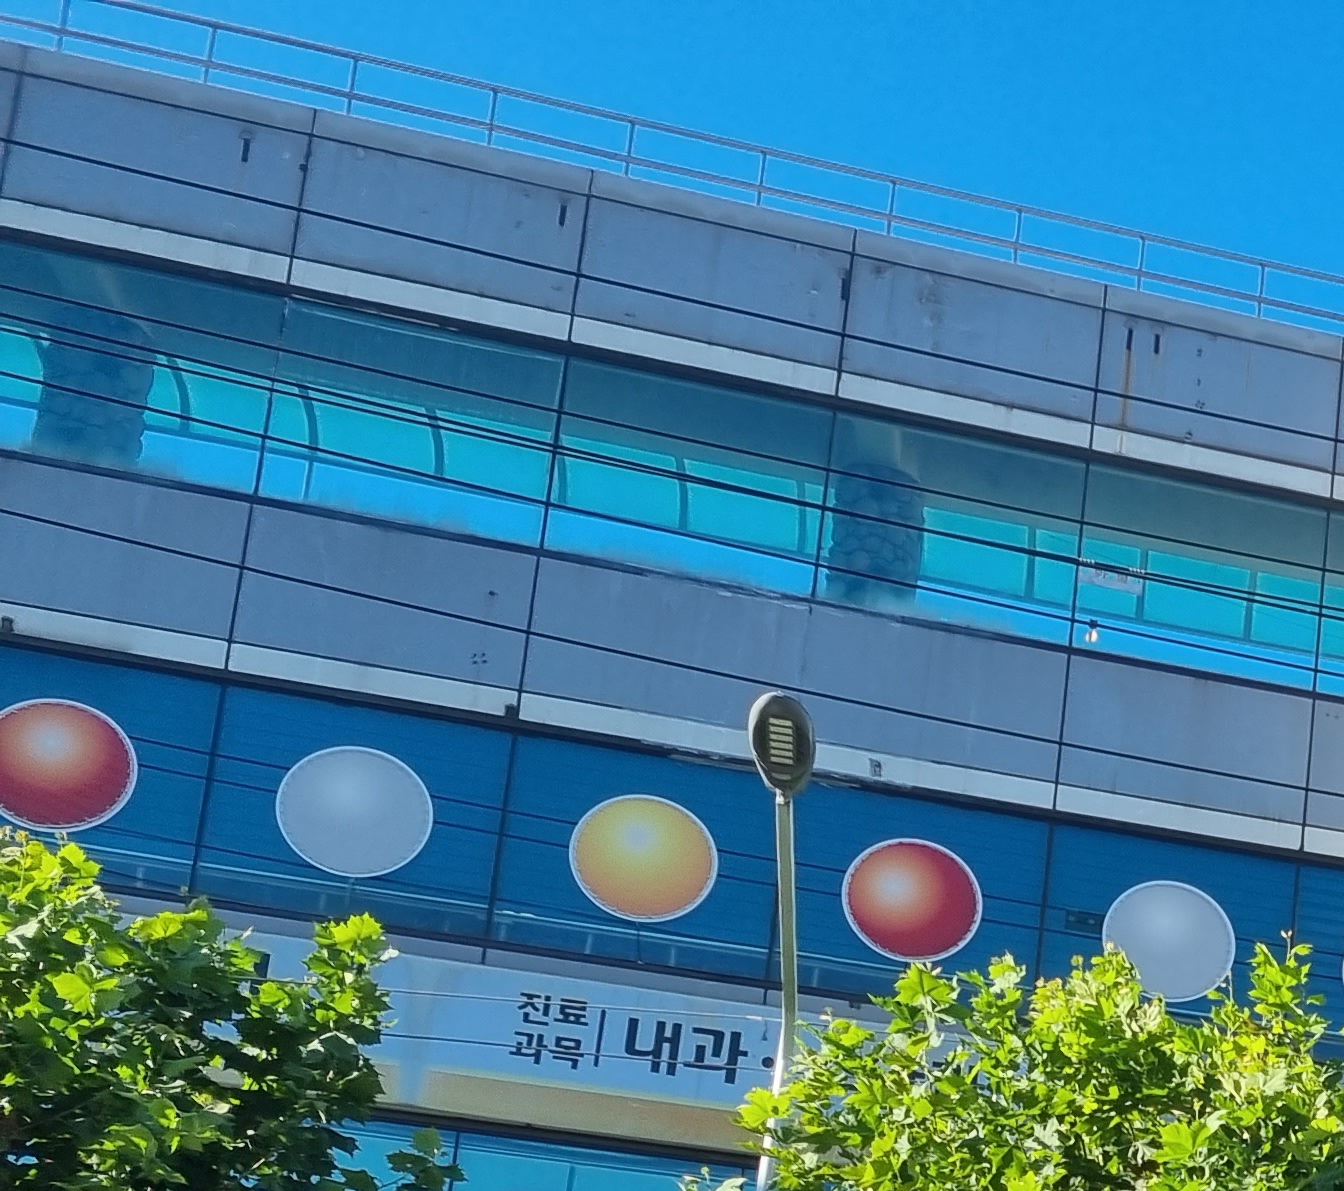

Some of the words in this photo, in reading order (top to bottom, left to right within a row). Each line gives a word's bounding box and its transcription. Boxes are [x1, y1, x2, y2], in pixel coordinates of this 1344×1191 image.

[516, 991, 590, 1028] 진료
[508, 1030, 585, 1071] 과목
[624, 1015, 749, 1085] 내과
